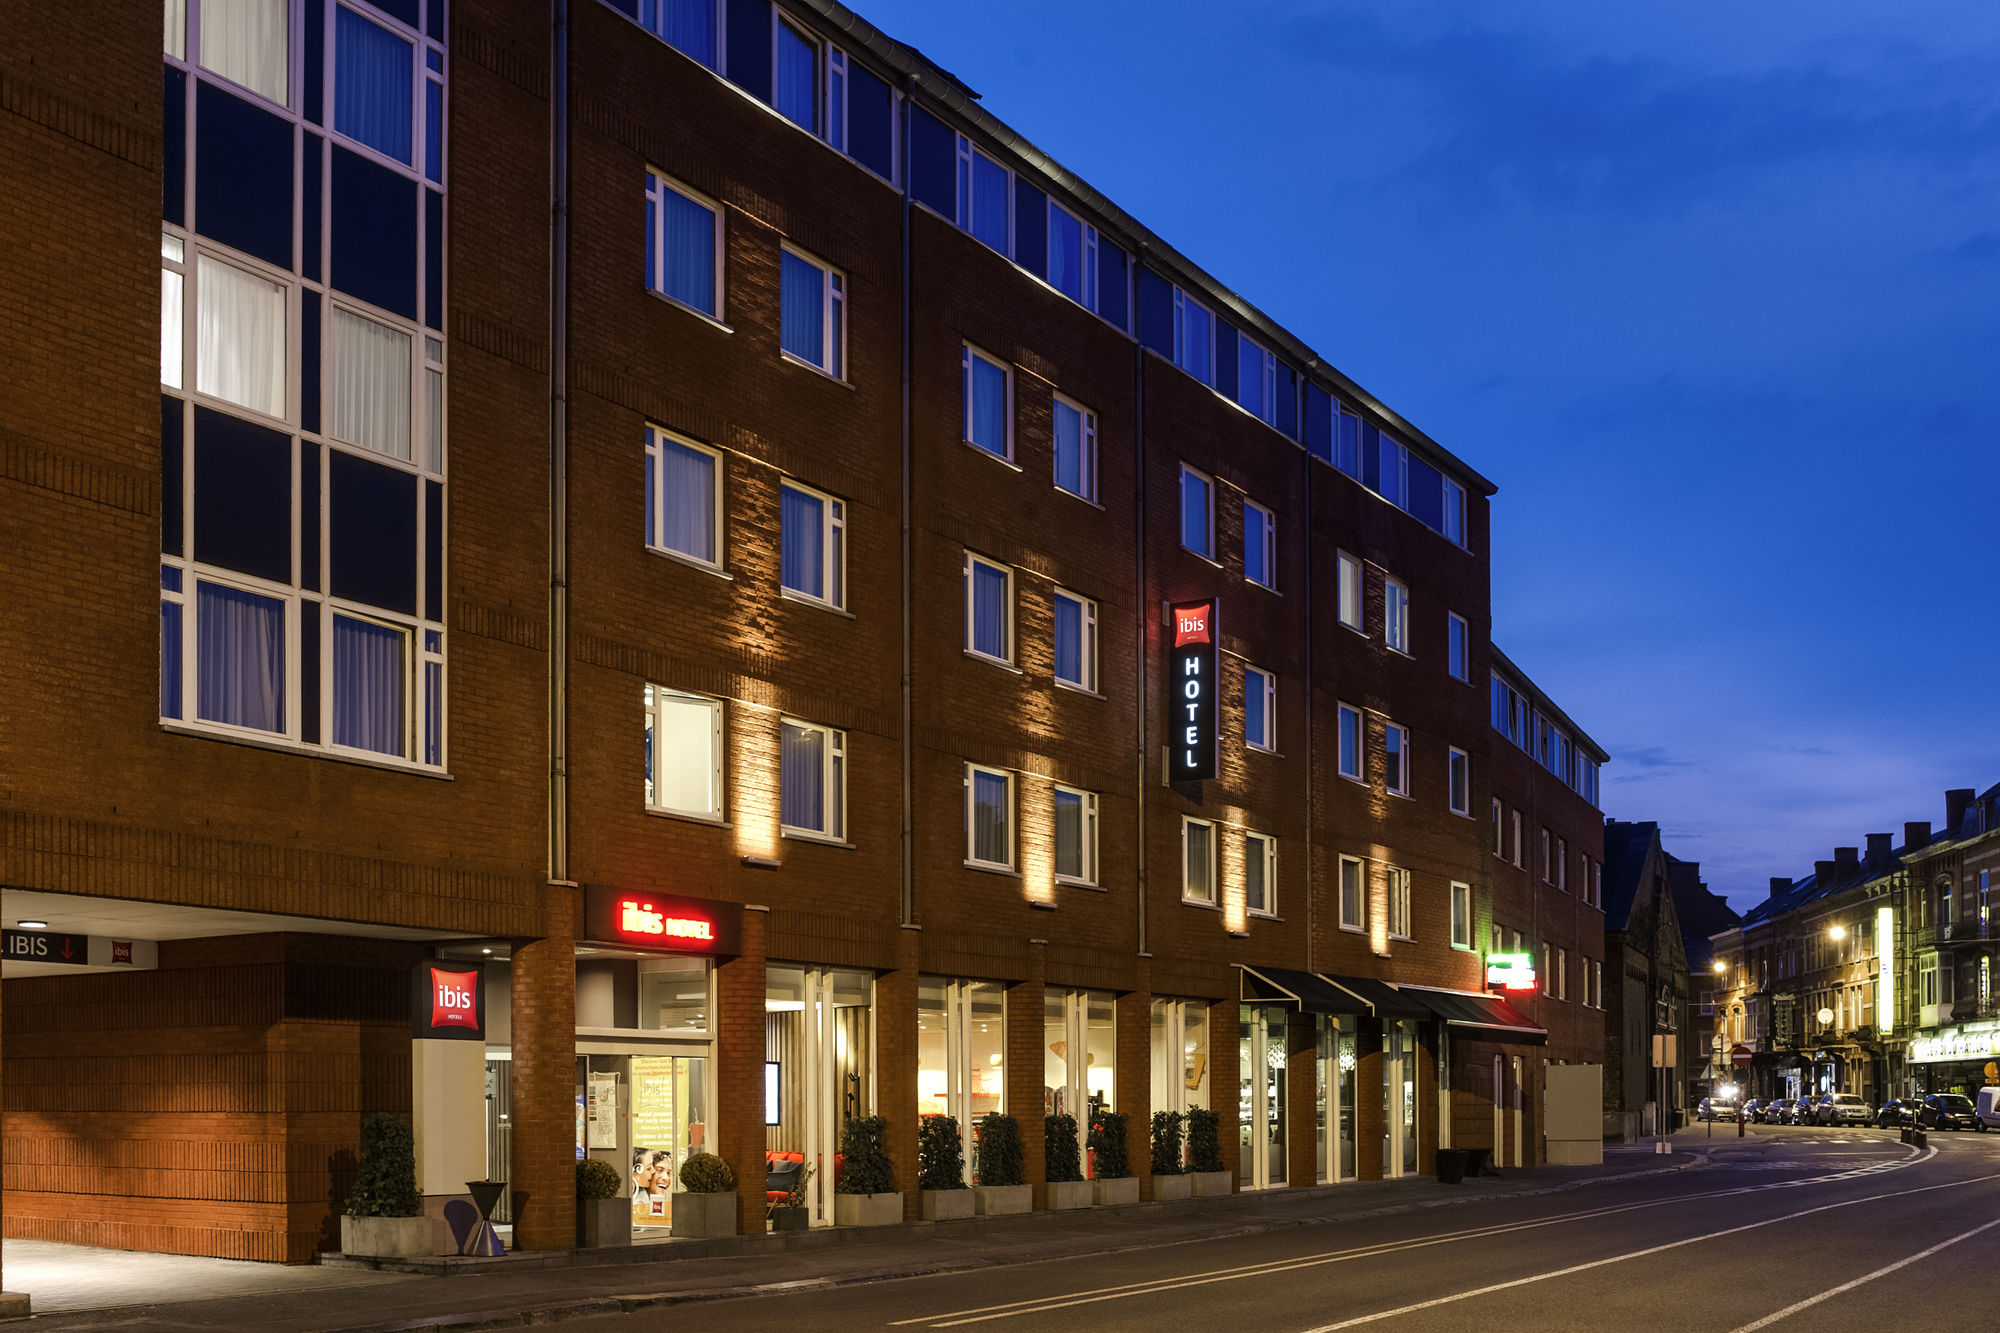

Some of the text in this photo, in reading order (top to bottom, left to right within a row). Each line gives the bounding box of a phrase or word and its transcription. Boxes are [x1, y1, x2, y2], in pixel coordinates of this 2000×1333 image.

[1180, 616, 1204, 633] ibis
[1184, 656, 1200, 768] HOTEL
[622, 901, 664, 934] ibis
[10, 935, 48, 956] IBIS
[114, 946, 129, 956] ibis
[439, 984, 471, 1009] ibis
